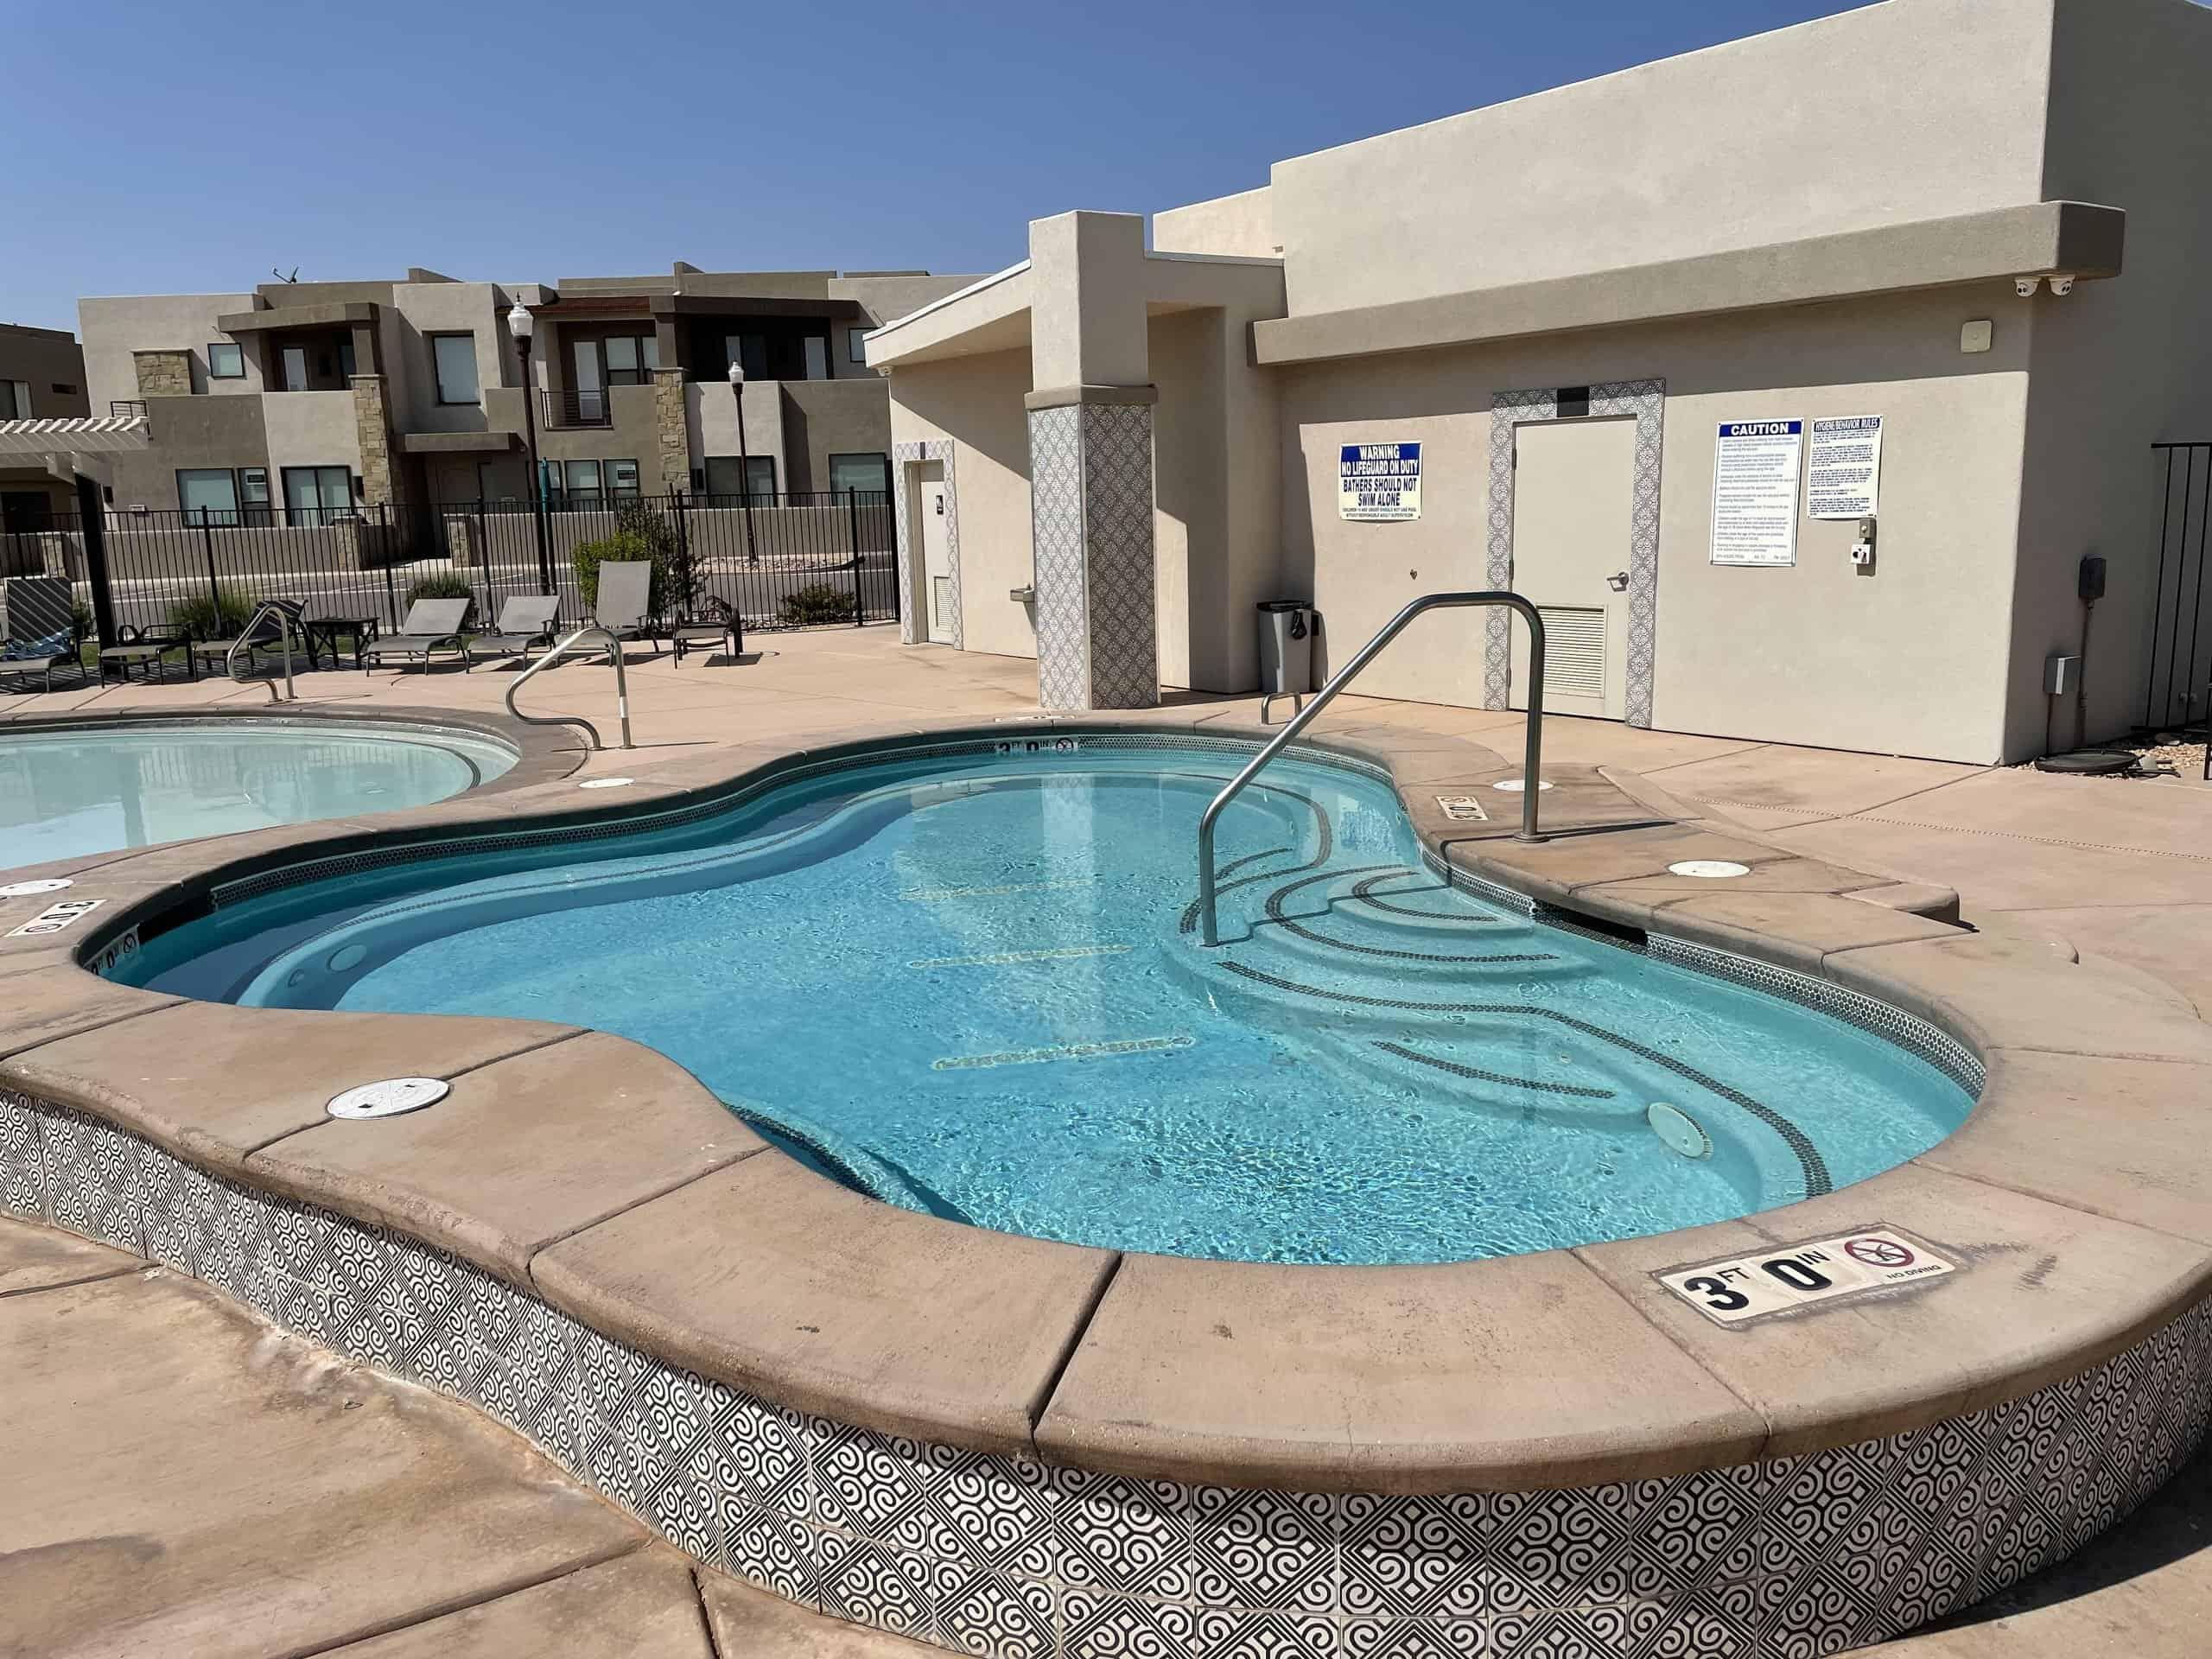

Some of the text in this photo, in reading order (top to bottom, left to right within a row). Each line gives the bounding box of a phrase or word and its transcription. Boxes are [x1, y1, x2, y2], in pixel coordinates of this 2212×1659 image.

[1731, 423, 1789, 435] CAUTION
[1860, 417, 1878, 429] RULES
[1359, 445, 1400, 460] WARNING
[1341, 460, 1418, 475] NO LIFEGUARD ON DUTY
[1344, 477, 1417, 493] BATHERS SHOULD NOT
[1358, 493, 1400, 506] SWIM ALONE
[1904, 1265, 1942, 1276] DIVING
[1684, 1250, 1833, 1311] 3 FT 0 IN
